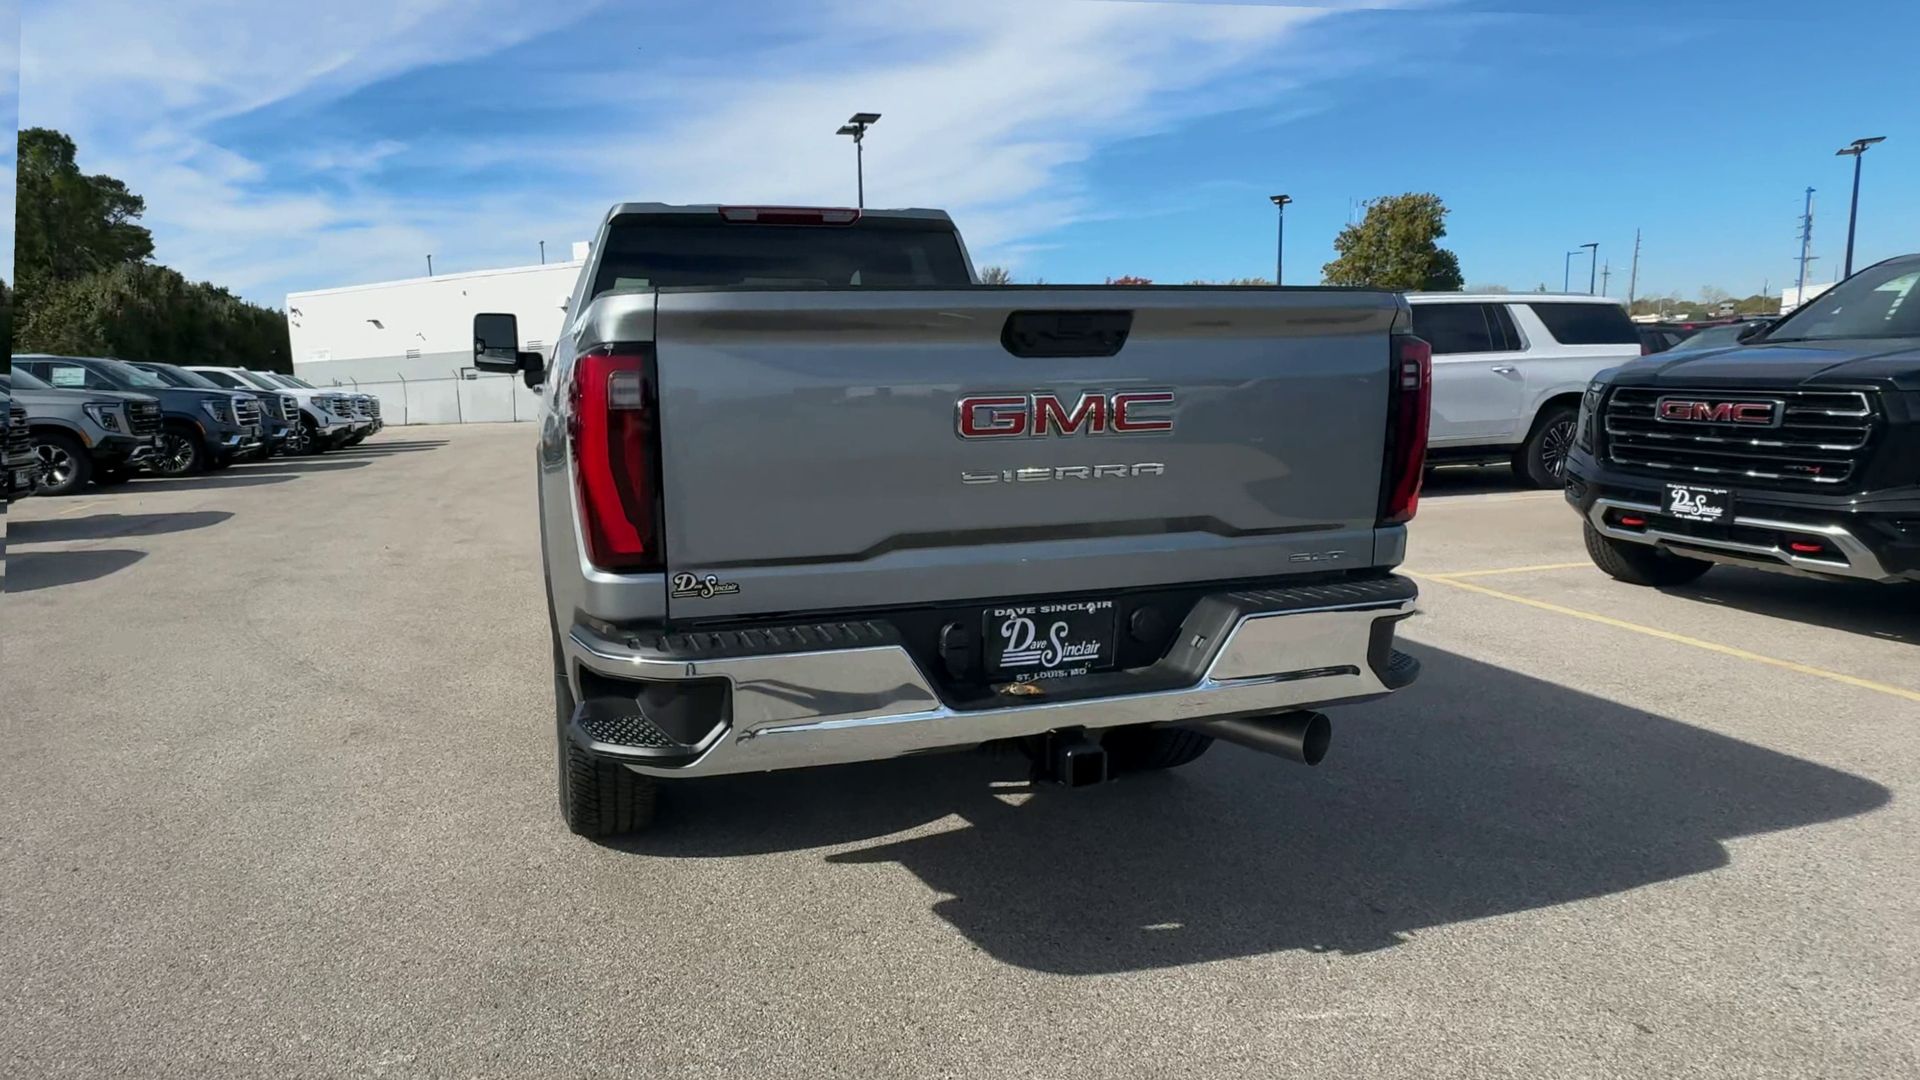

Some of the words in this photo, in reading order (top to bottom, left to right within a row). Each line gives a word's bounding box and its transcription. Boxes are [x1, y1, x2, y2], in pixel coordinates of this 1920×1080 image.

[957, 392, 1174, 438] GMC
[1661, 400, 1773, 424] GMC
[961, 463, 1165, 484] SIERRA
[994, 606, 1036, 618] DAVE
[1040, 601, 1112, 614] SINCLAIR
[1001, 617, 1047, 652] Dave
[1041, 621, 1101, 667] Sinclair
